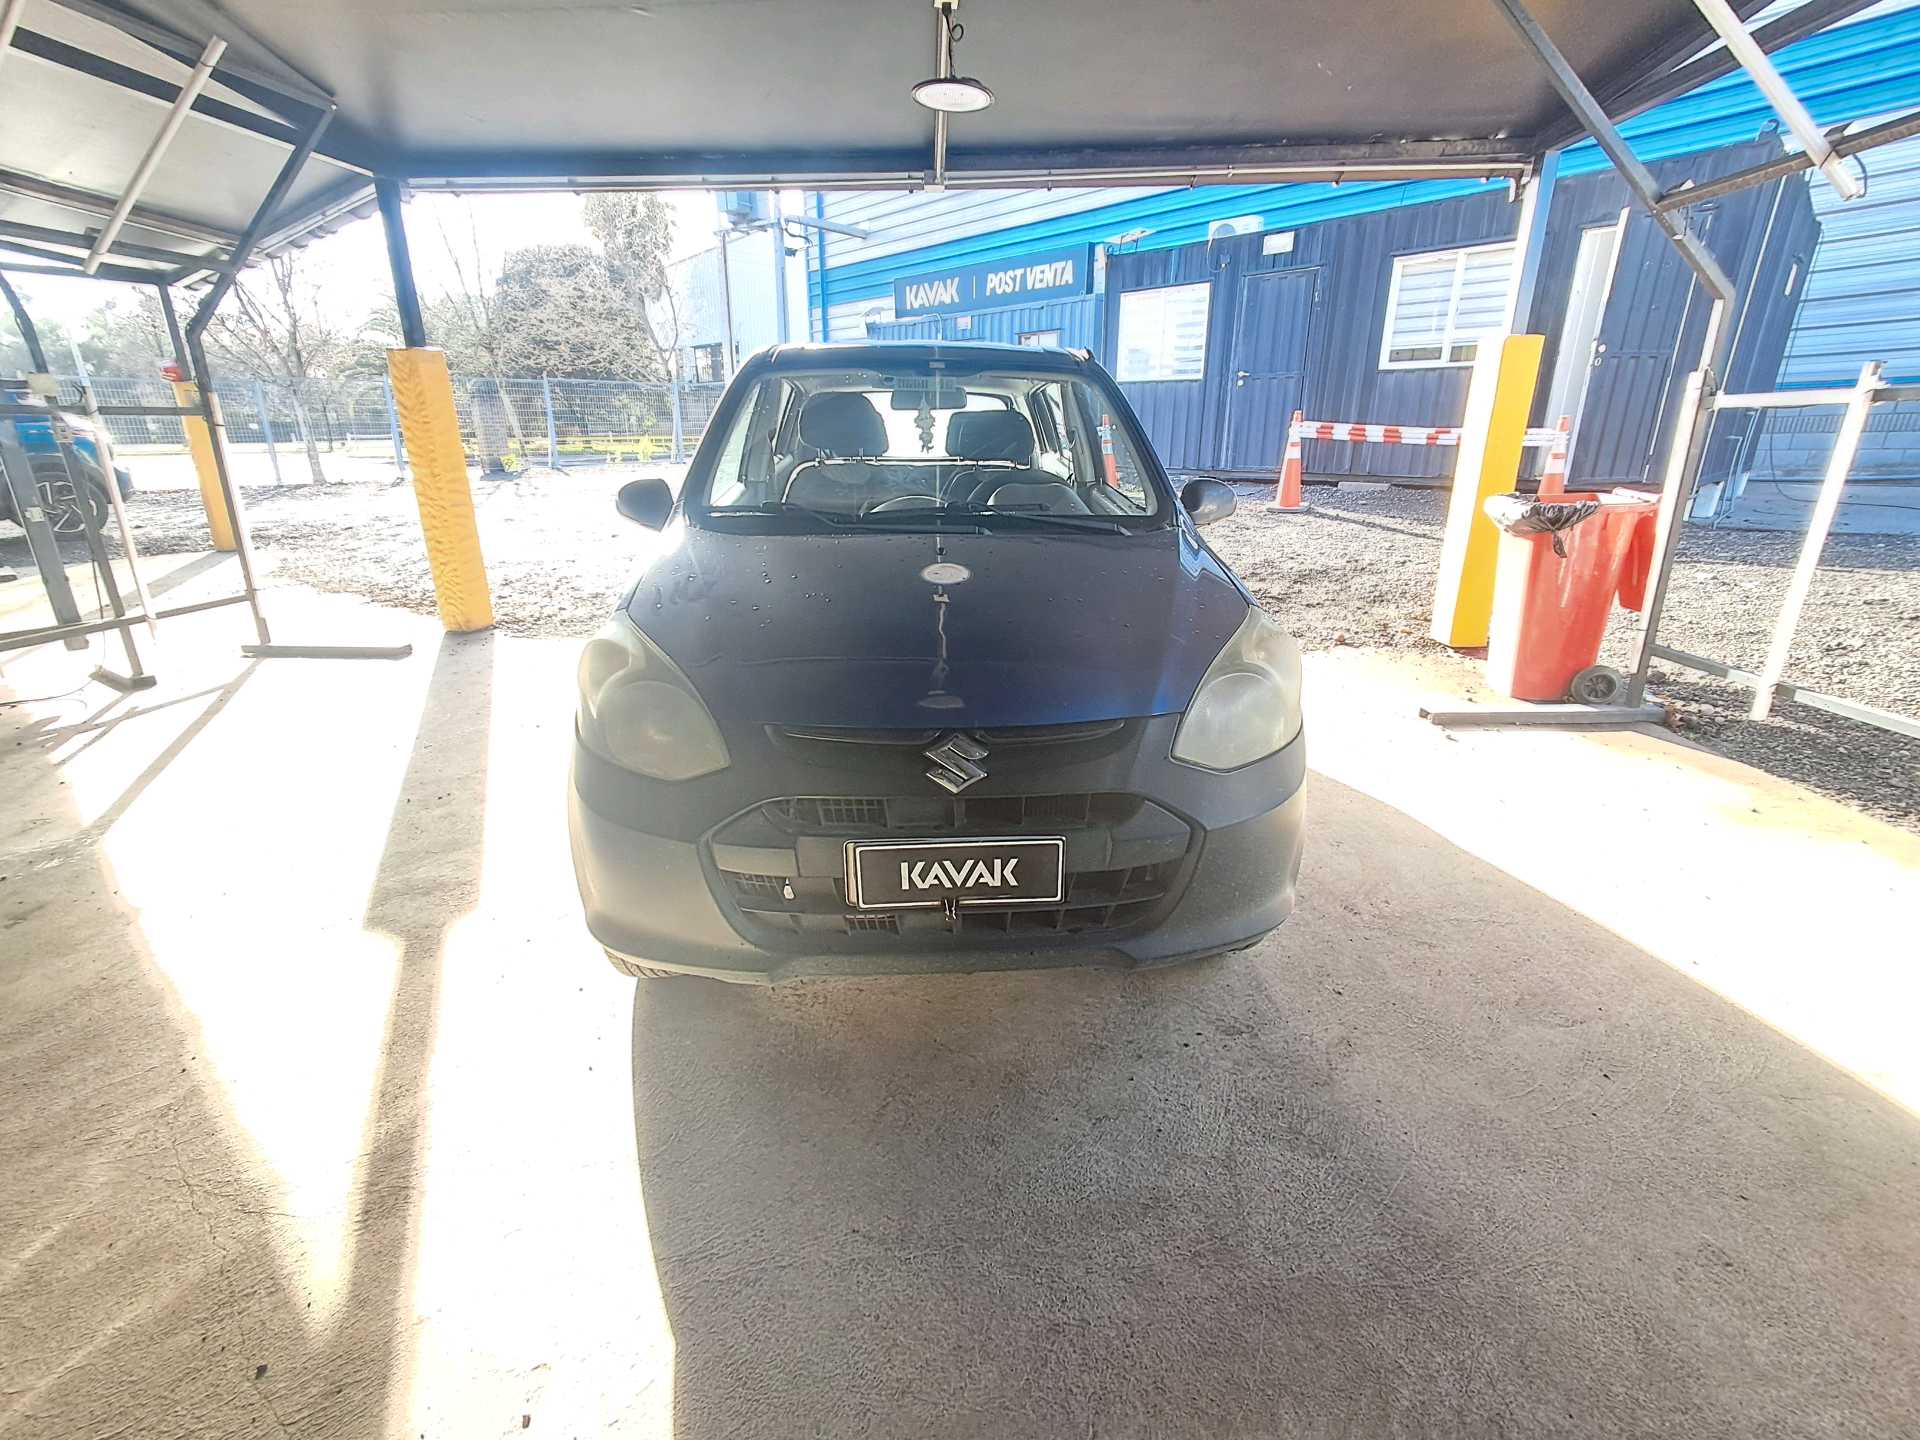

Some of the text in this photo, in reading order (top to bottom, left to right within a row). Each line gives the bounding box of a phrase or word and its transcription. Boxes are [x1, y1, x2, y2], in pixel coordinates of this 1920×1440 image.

[905, 260, 1073, 310] KAVAK POST VENTA
[900, 858, 1019, 890] KAVAK
